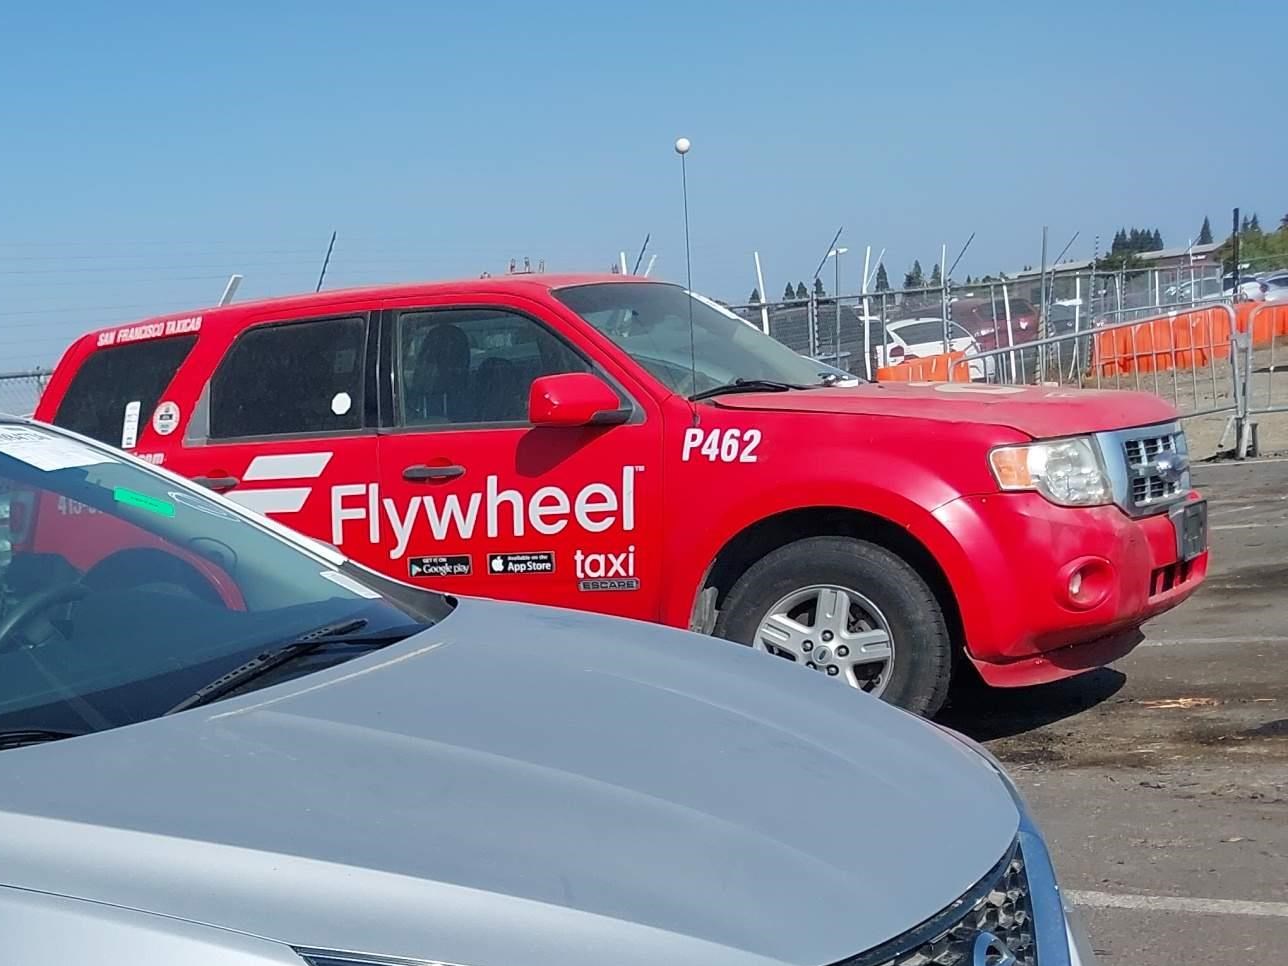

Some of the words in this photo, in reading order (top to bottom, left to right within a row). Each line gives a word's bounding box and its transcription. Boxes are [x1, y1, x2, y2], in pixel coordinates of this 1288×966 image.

[97, 331, 116, 347] SAN
[117, 323, 165, 343] FRANCISCO
[165, 316, 202, 335] TAXICAB
[682, 428, 762, 463] P462
[330, 466, 634, 560] Flywheel
[422, 563, 453, 576] Google
[453, 563, 469, 574] play
[507, 561, 527, 573] App
[526, 561, 552, 571] Store
[574, 545, 635, 578] taxi
[581, 580, 636, 590] ESCAPE
